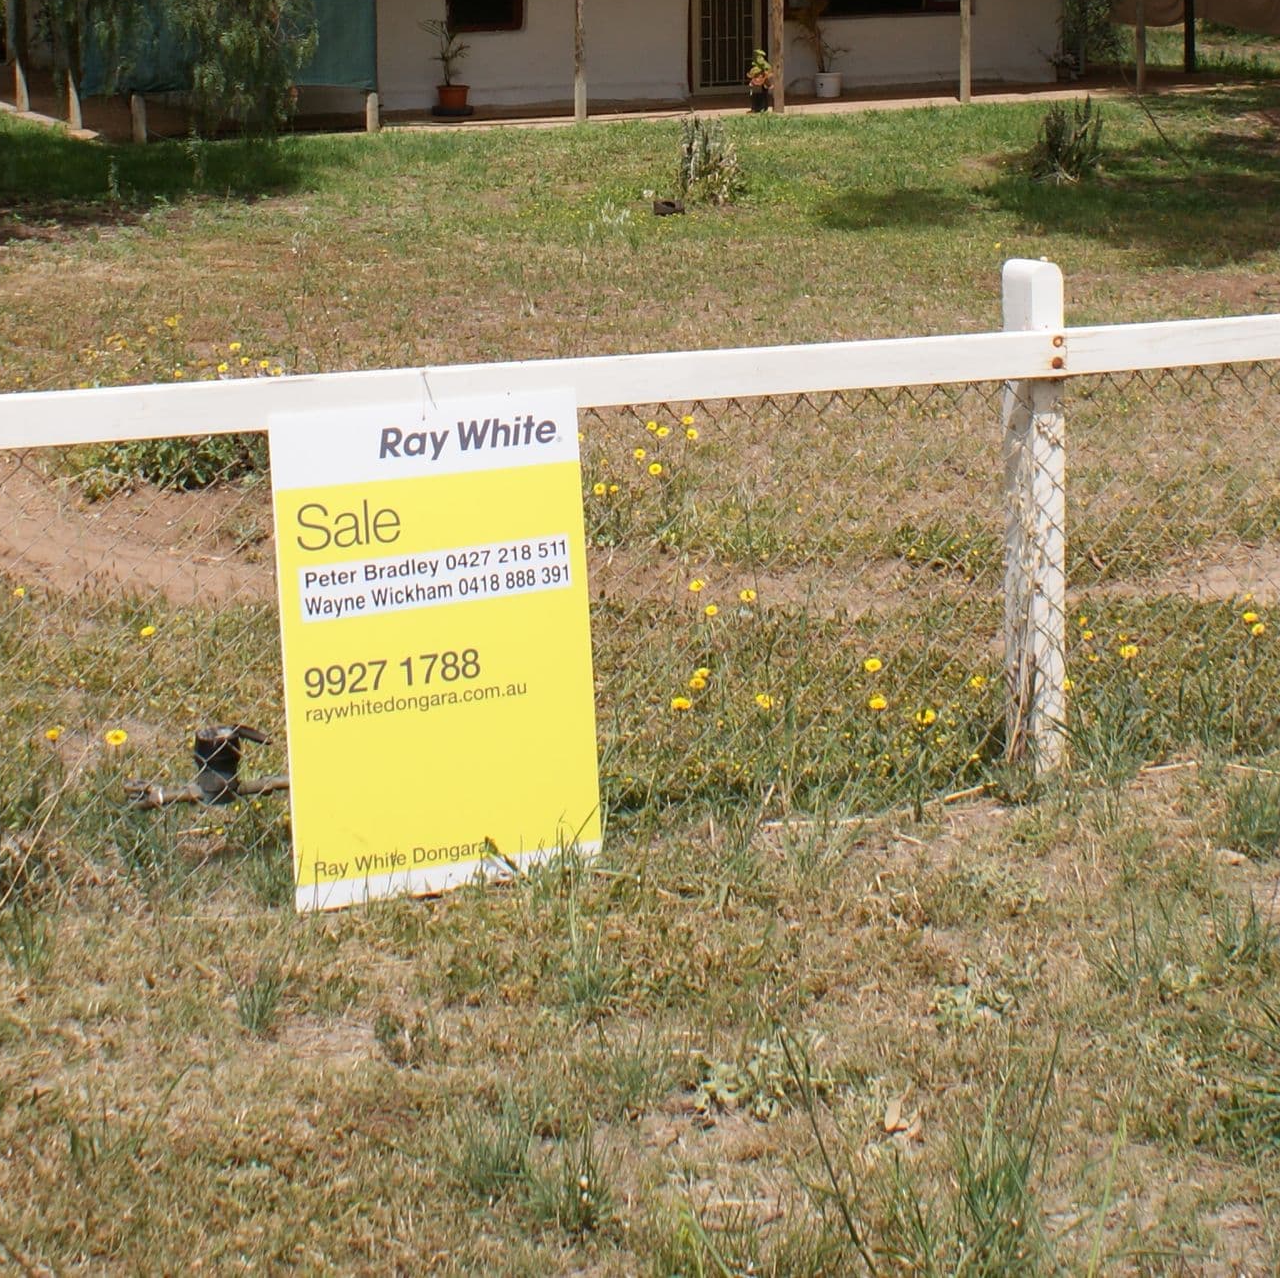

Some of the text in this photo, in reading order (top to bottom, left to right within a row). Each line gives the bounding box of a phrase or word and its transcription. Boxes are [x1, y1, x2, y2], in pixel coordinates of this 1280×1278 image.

[379, 415, 557, 461] Ray White
[297, 499, 401, 551] Sale
[305, 539, 567, 588] Peter Bradley 0427 218 511
[305, 565, 569, 617] Wayne Wickham 0418 888 391
[304, 648, 481, 699] 9927 1788
[305, 683, 527, 723] raywhitedongara.com.au
[315, 861, 349, 879] Ray
[354, 848, 407, 871] White
